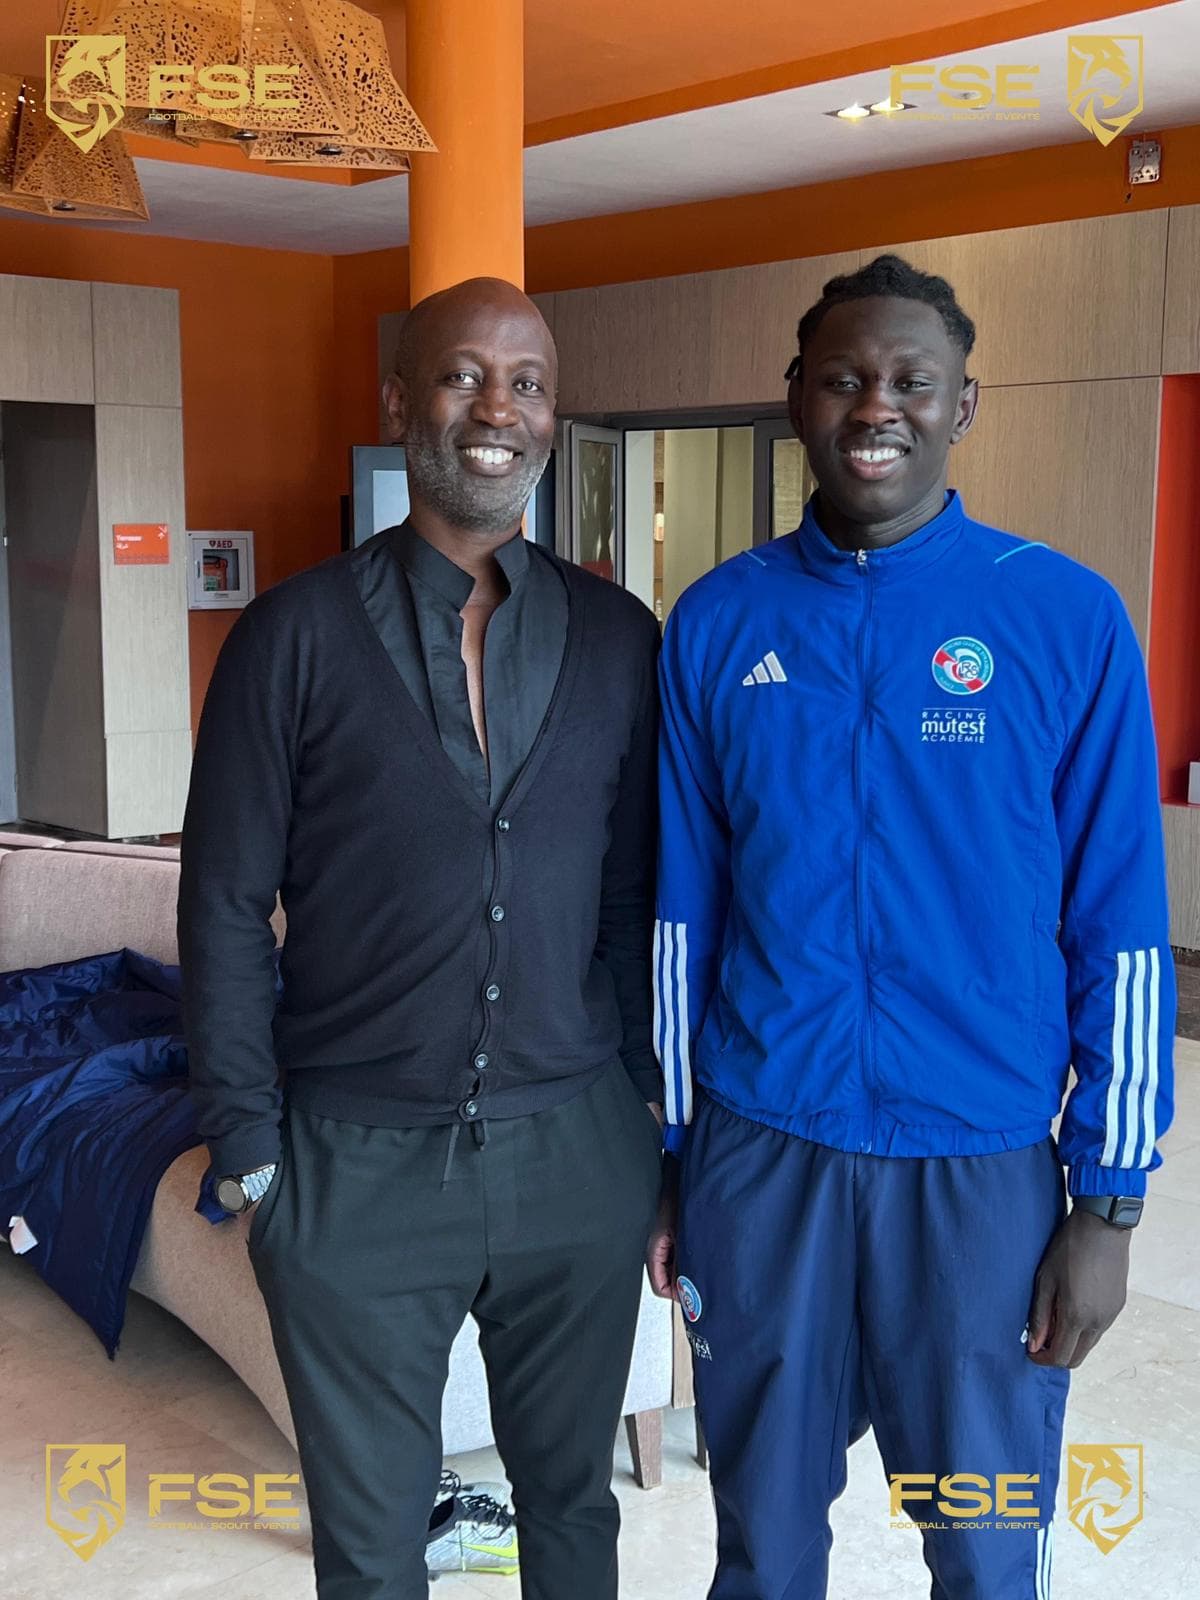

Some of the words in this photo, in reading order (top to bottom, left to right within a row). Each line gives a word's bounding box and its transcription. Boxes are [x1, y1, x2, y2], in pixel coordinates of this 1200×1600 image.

[216, 540, 233, 548] AED
[921, 711, 987, 720] RACING
[921, 718, 986, 735] mutest
